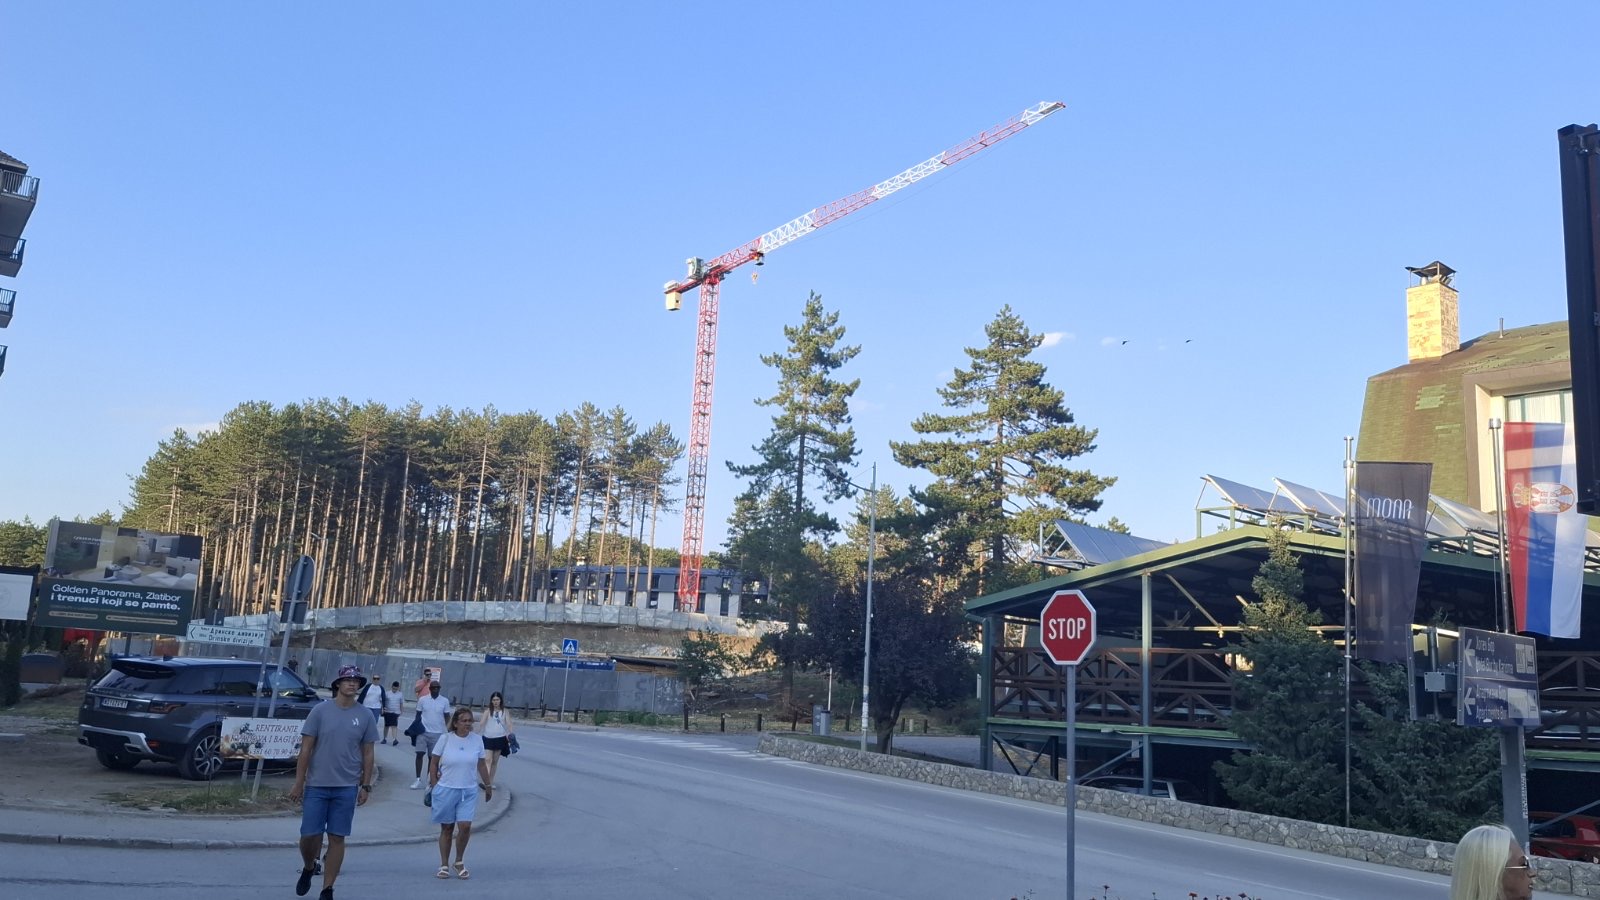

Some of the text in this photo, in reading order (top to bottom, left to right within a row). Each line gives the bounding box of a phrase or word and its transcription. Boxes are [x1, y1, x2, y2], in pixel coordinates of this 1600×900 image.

[50, 592, 55, 600] i
[57, 594, 99, 605] trenuci
[101, 597, 123, 607] koji
[141, 601, 181, 611] pamte.
[52, 583, 181, 602] Golden Panorama, Zlatibor
[208, 634, 229, 642] Drinske
[1048, 617, 1086, 640] STOP
[255, 723, 299, 733] RENTIRANJE
